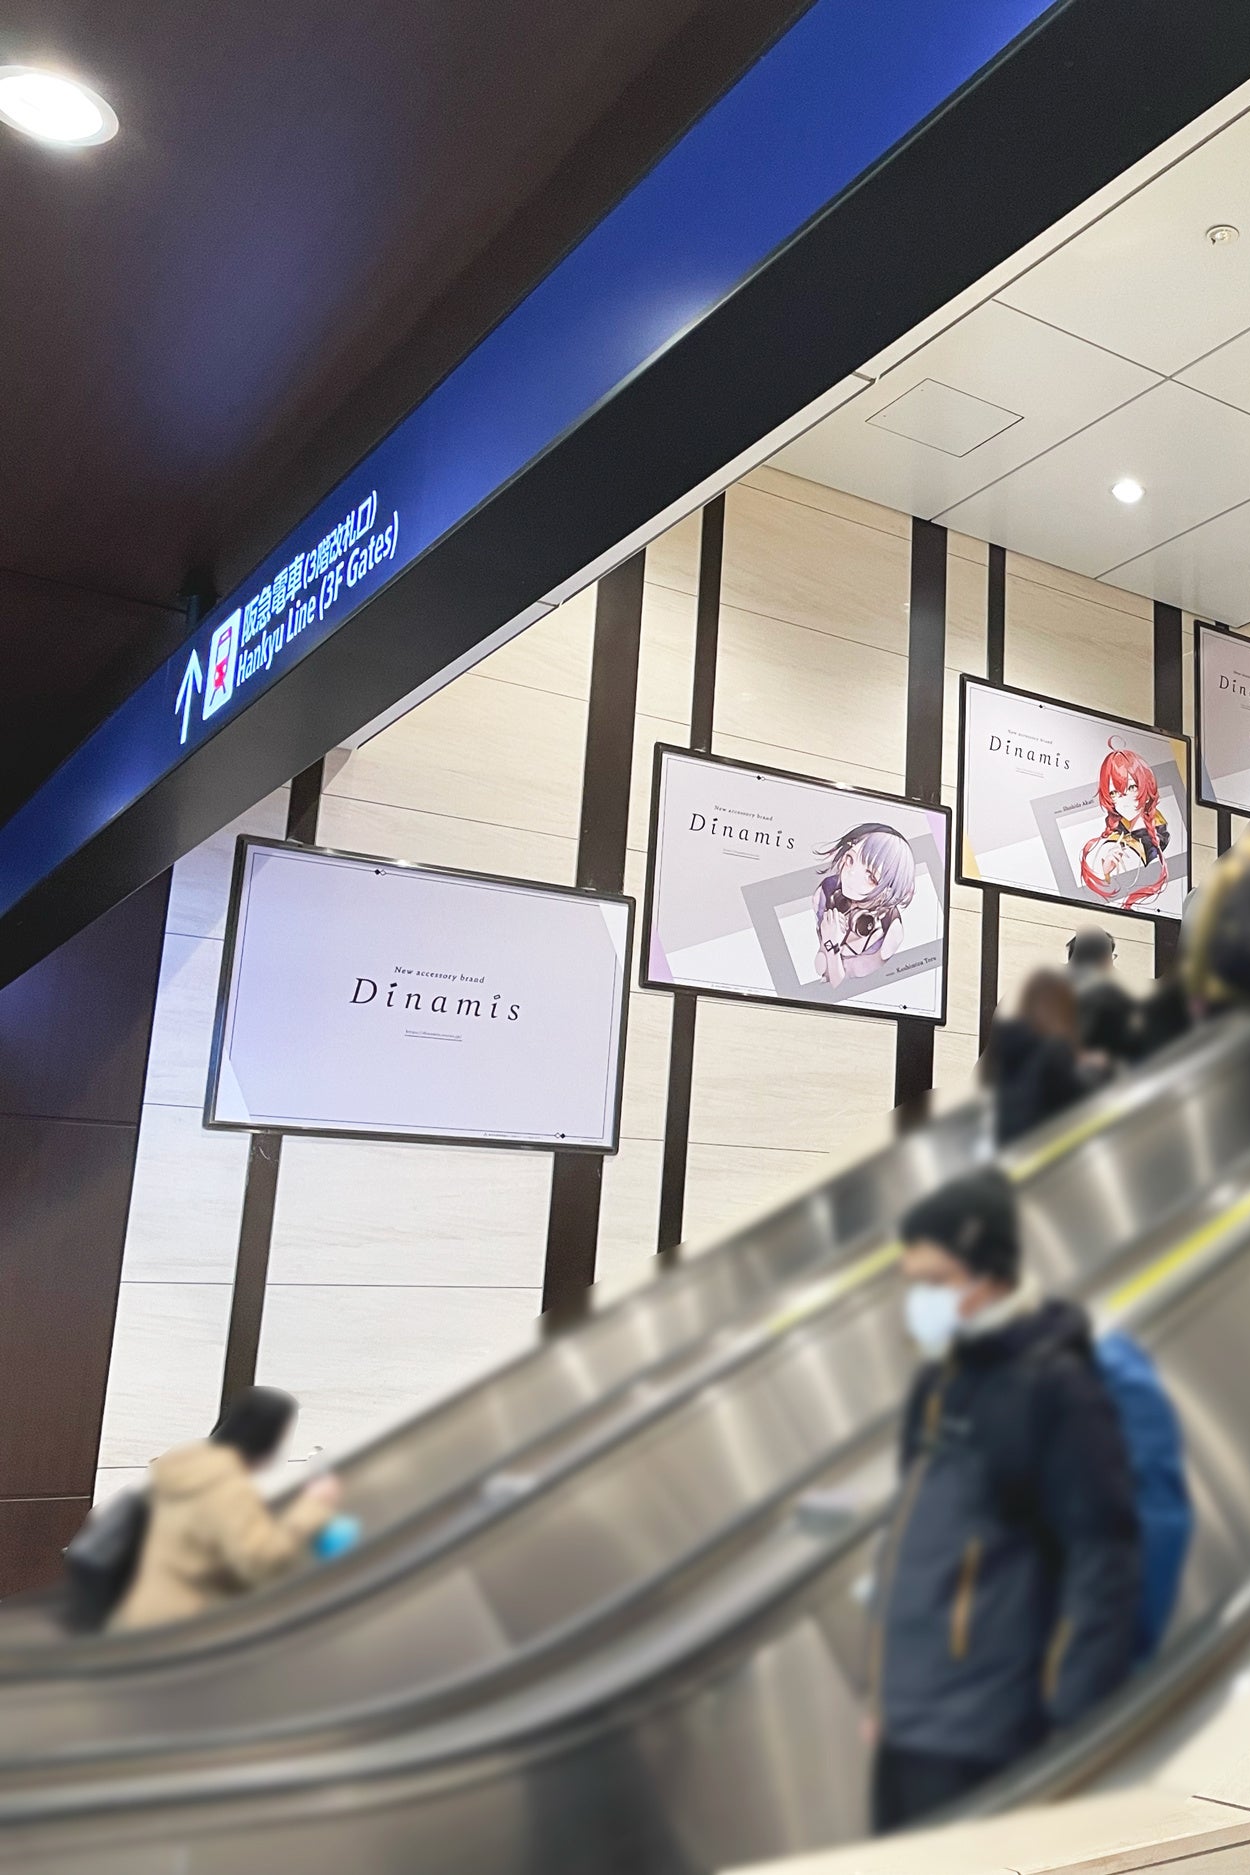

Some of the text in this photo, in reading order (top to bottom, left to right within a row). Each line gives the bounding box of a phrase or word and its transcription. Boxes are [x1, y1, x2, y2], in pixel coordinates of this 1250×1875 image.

[241, 490, 377, 647] 阪急電車(3階改札口)
[236, 511, 398, 687] Hankyu Line (3F Gates)
[989, 735, 1071, 770] Dinamis
[689, 813, 795, 850] Dinamis
[394, 966, 486, 984] New accessory brand
[349, 977, 521, 1021] Dinamis
